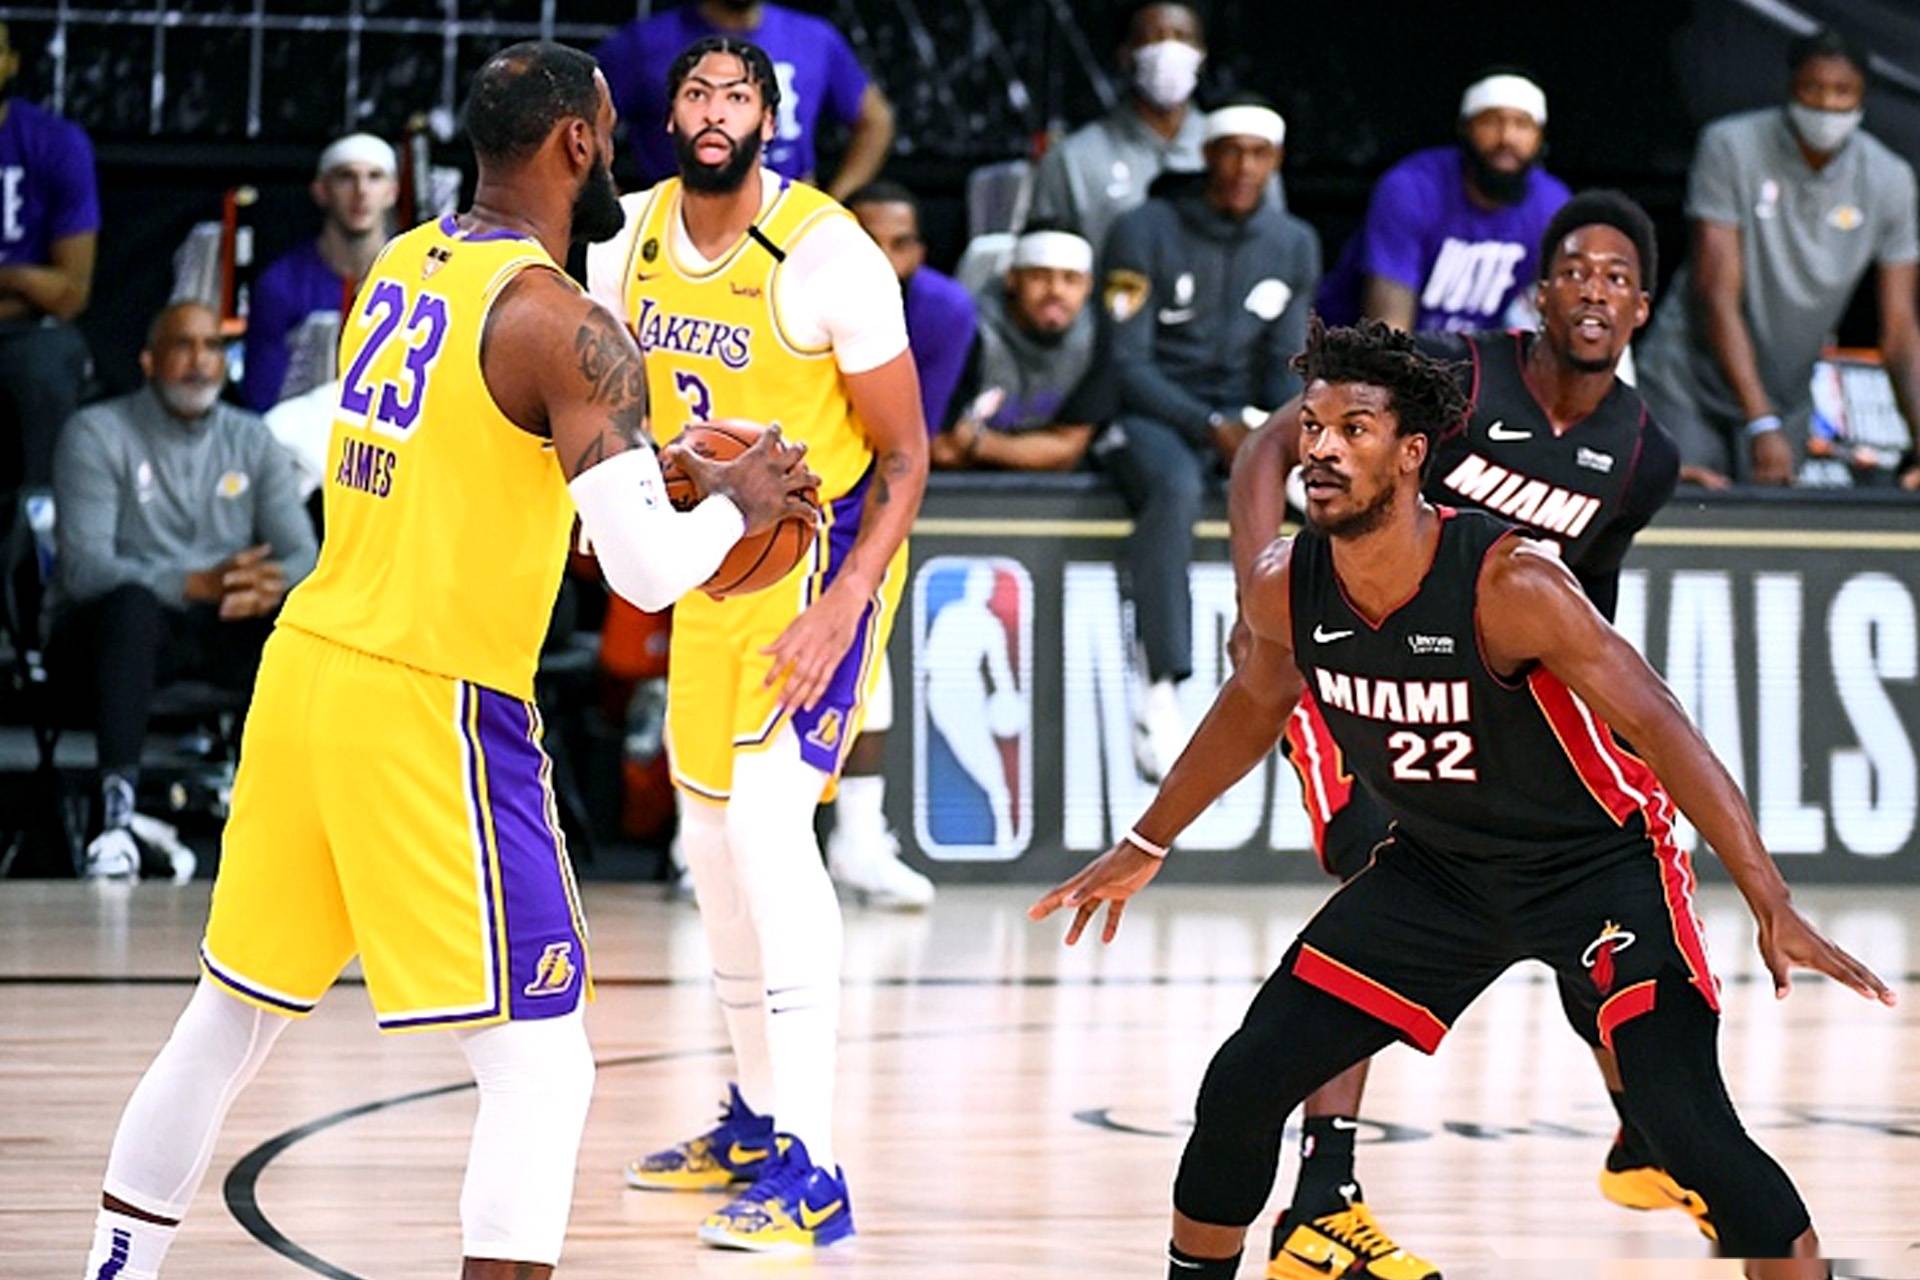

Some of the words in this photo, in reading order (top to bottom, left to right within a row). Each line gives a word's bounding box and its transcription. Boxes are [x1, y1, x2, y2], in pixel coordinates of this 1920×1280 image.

[336, 279, 450, 435] 23
[636, 299, 750, 368] LAKERS
[675, 371, 711, 422] 3
[335, 436, 396, 498] JAMES
[1443, 453, 1602, 538] MIAMI
[1314, 666, 1470, 724] MIAMI
[1386, 730, 1477, 781] 22
